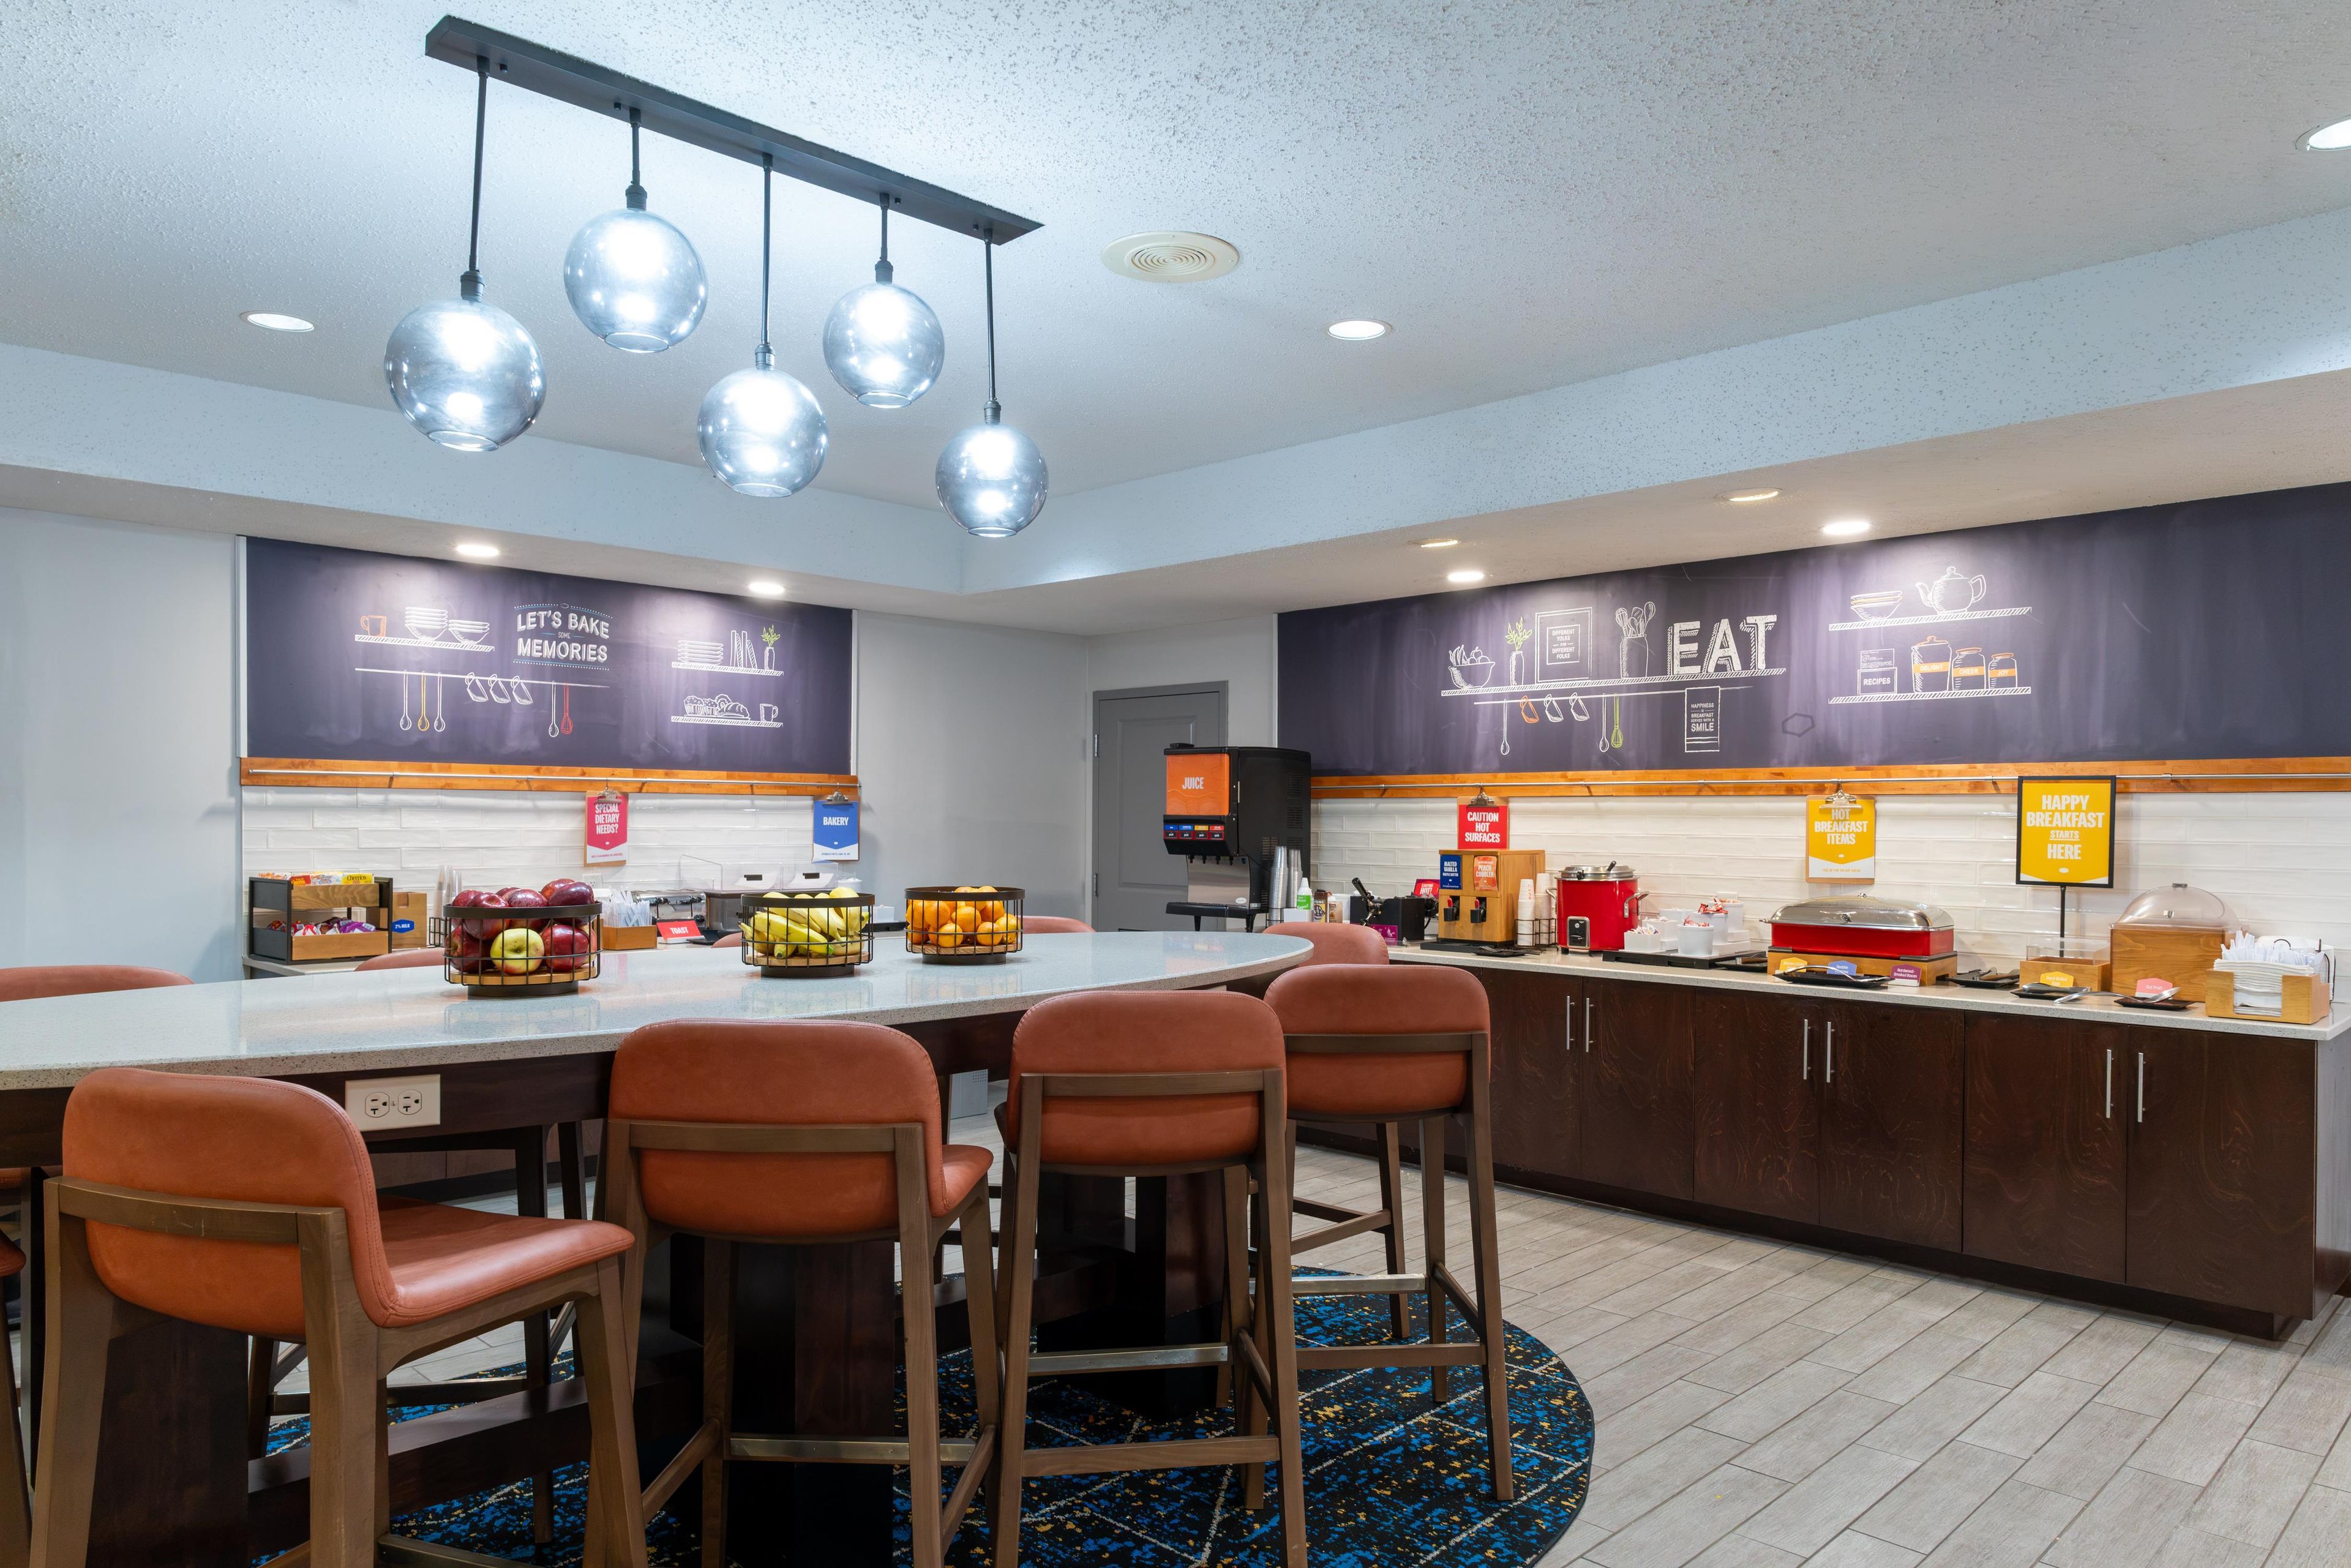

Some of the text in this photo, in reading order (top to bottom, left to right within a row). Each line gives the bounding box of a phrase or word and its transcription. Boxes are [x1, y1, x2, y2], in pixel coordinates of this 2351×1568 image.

[517, 610, 609, 639] LET'S BAKE
[517, 638, 607, 662] MEMORIES
[1667, 615, 1777, 675] EAT
[1691, 722, 1714, 732] SMILE
[1182, 776, 1204, 789] JUICE
[595, 803, 619, 814] SPECIAL
[2042, 795, 2090, 811] HAPPY
[595, 814, 620, 824] DIETARY
[1467, 811, 1499, 822] CAUTION
[1831, 808, 1851, 820] HOT
[2026, 811, 2105, 828] BREAKFAST
[823, 817, 849, 826] BAKERY
[1475, 822, 1490, 832] HOT
[1814, 821, 1869, 833] BREAKFAST
[596, 823, 618, 835] NEEDS?
[2050, 830, 2079, 839] STARTS
[1464, 832, 1500, 843] SURFACES
[1826, 833, 1856, 844] ITEMS
[2047, 843, 2082, 860] HERE
